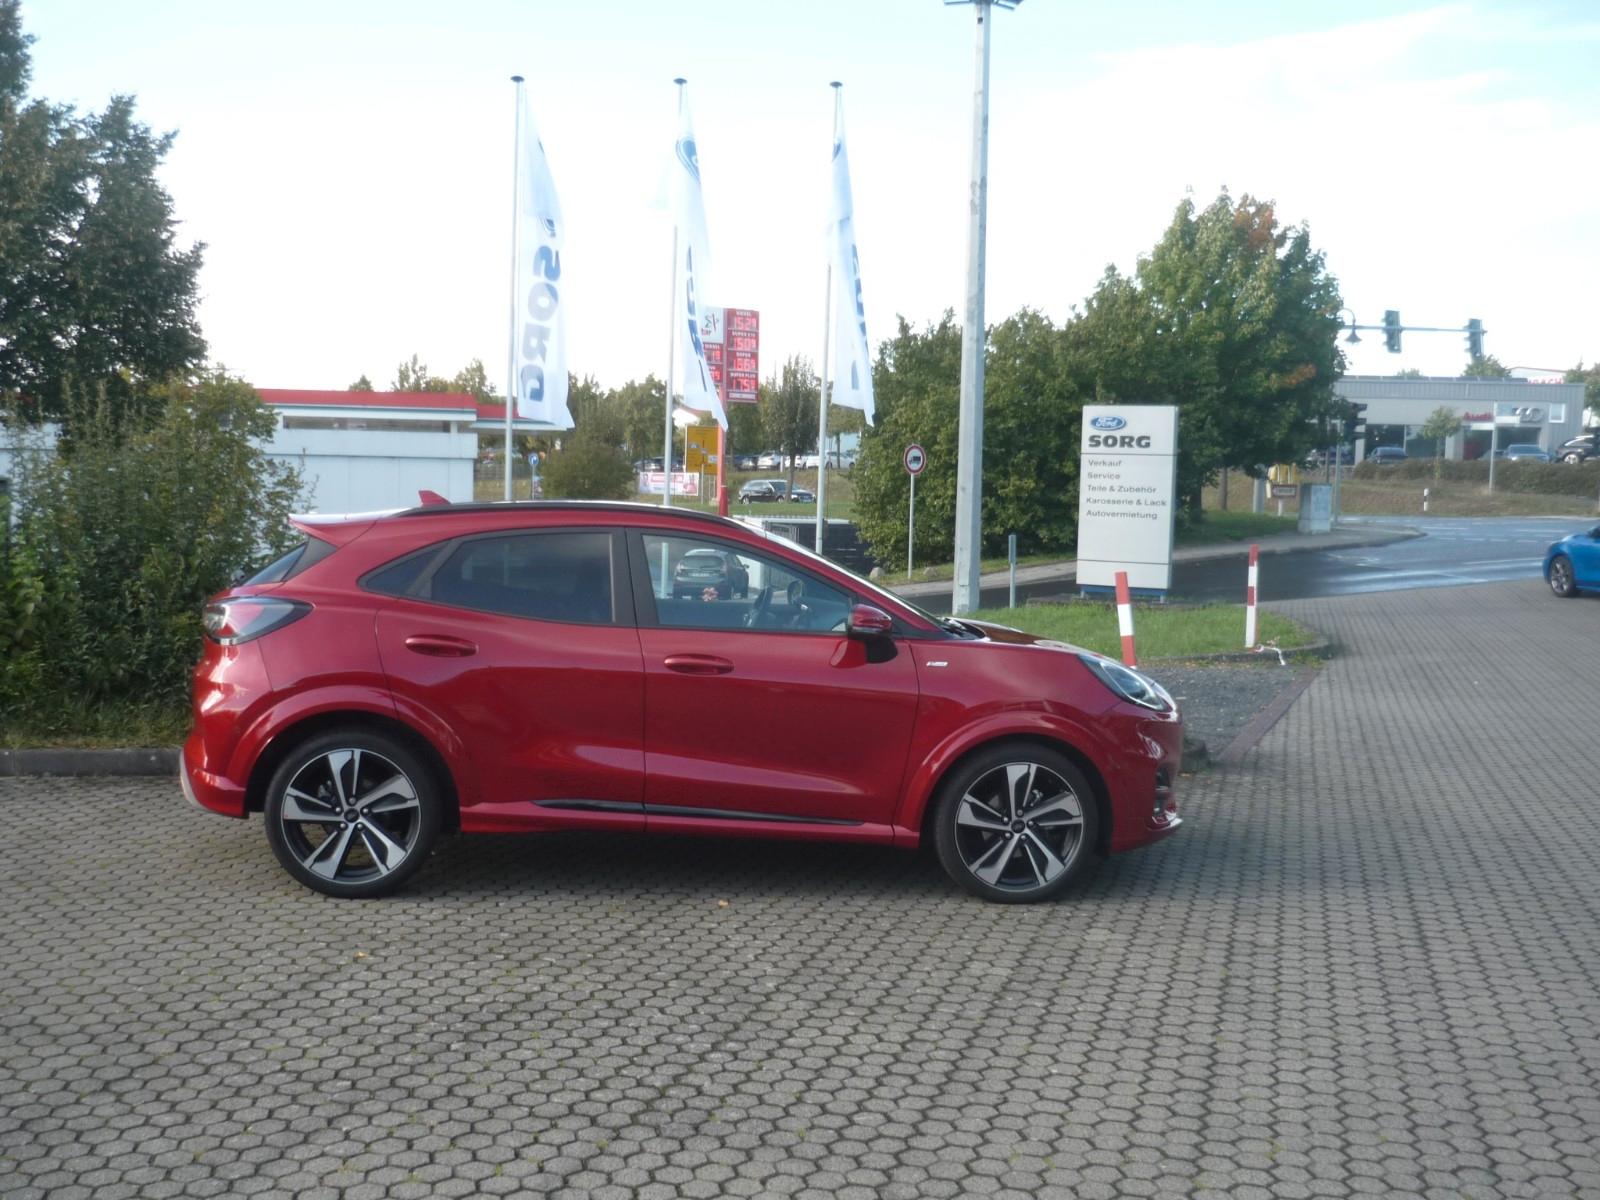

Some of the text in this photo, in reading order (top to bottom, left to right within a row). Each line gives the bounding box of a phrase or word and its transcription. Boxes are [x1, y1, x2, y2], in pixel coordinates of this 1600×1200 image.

[1088, 434, 1151, 449] SORG
[1088, 459, 1122, 467] Verkauf
[1087, 472, 1121, 480] Service
[1087, 484, 1107, 492] Teile
[1117, 485, 1157, 493] Zubehör
[1086, 496, 1167, 507] Karosserie & Lack
[1086, 509, 1158, 520] Autovermietung
